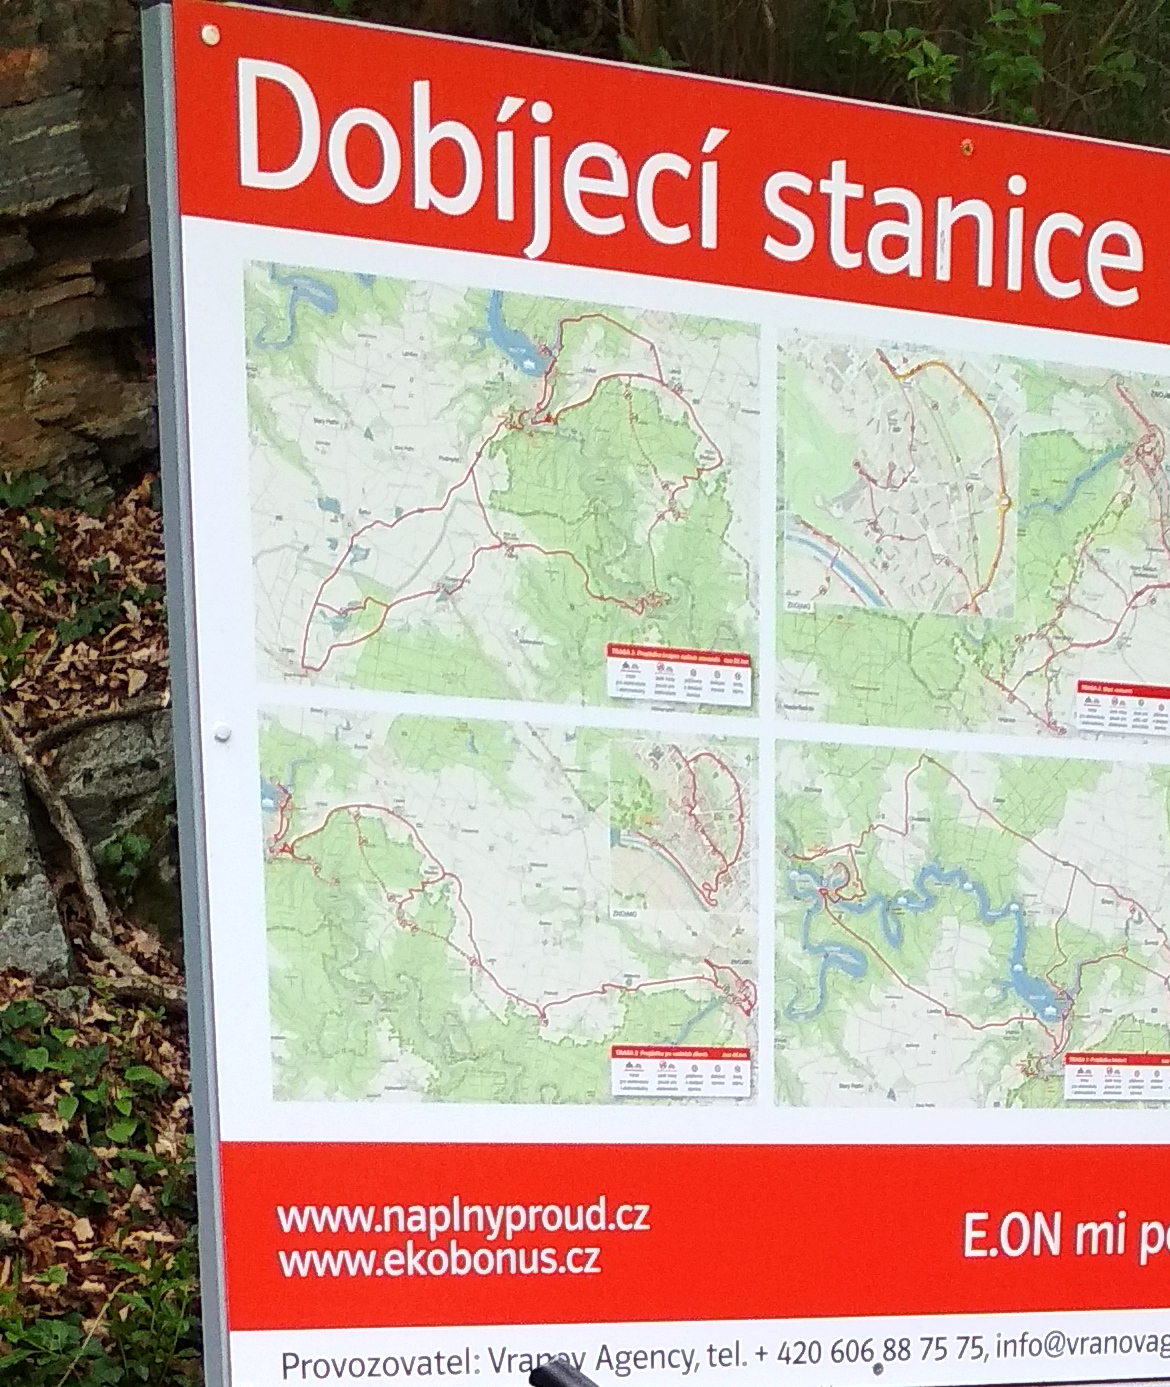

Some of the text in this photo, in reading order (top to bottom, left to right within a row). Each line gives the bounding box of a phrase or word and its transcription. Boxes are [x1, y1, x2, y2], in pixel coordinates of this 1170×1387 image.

[237, 56, 730, 261] Dobíjecí
[763, 159, 1144, 308] stanice
[276, 1194, 651, 1242] www.naplnyproud.cz
[963, 1210, 1062, 1258] E.ON
[1075, 1209, 1127, 1255] mi
[278, 1239, 601, 1278] www.ekobonus.cz
[282, 1346, 480, 1381] Provozovatel:
[595, 1344, 700, 1378] Agency,
[706, 1339, 748, 1368] tel.
[777, 1339, 822, 1366] 420
[830, 1338, 874, 1364] 606
[882, 1336, 911, 1363] 88
[919, 1336, 948, 1362] 75
[956, 1335, 990, 1364] 75,
